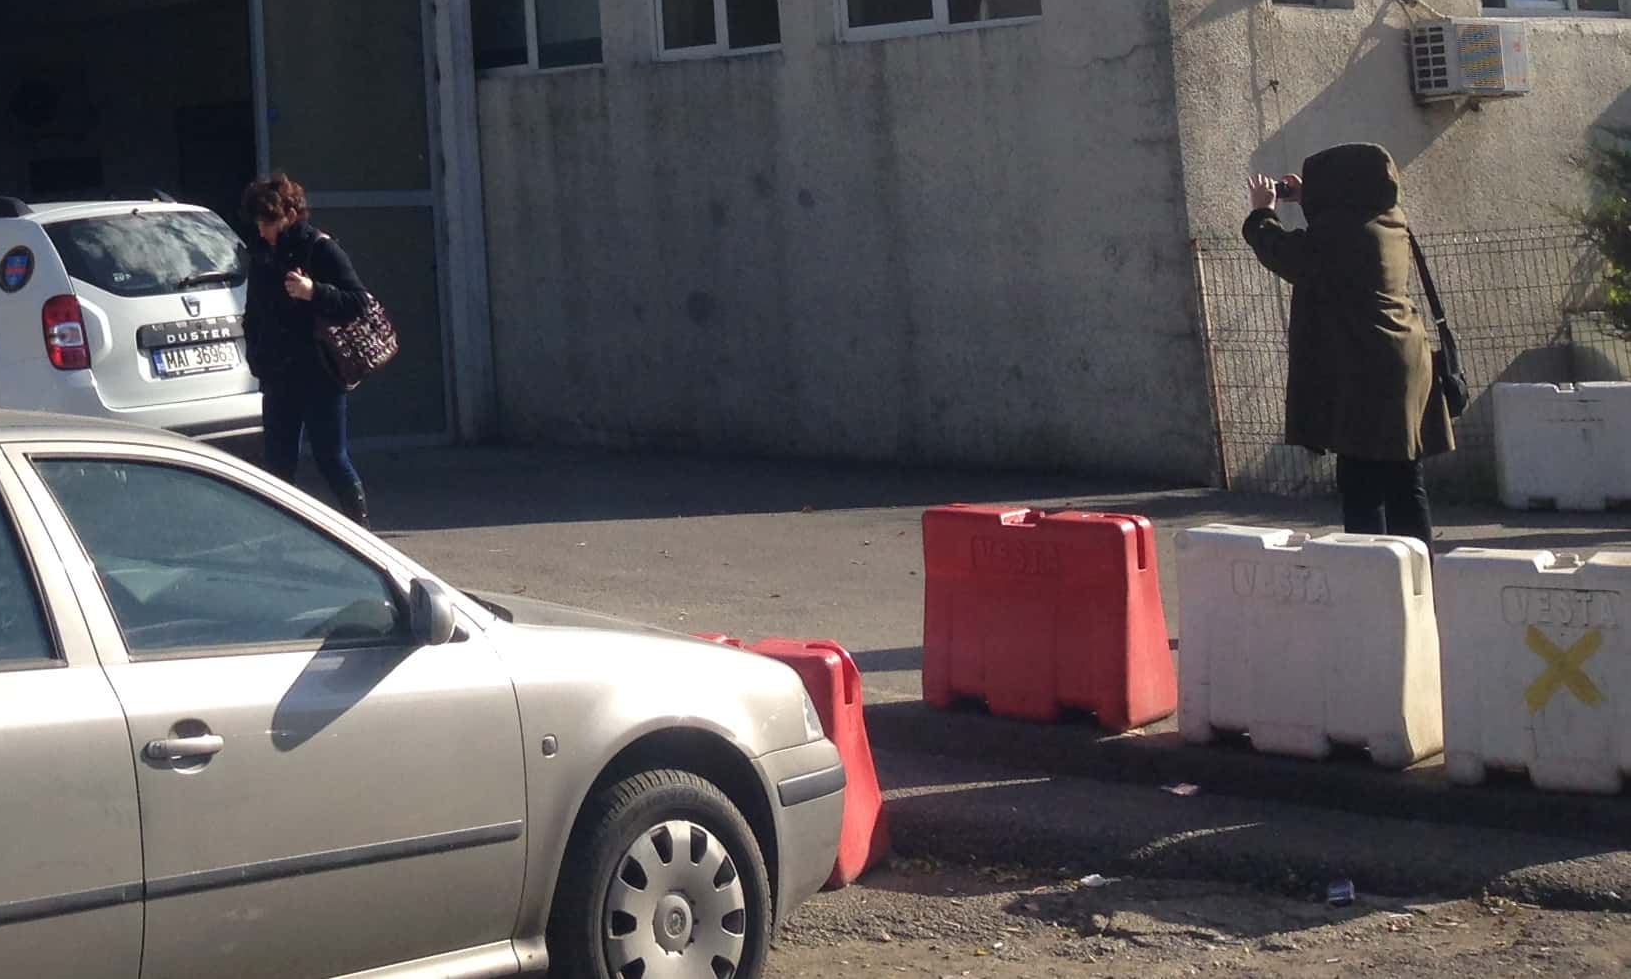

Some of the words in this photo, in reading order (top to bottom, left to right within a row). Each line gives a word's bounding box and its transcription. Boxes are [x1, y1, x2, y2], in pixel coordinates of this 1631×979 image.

[166, 327, 231, 344] DUSTER
[165, 349, 190, 370] MAI
[192, 342, 235, 365] 36963
